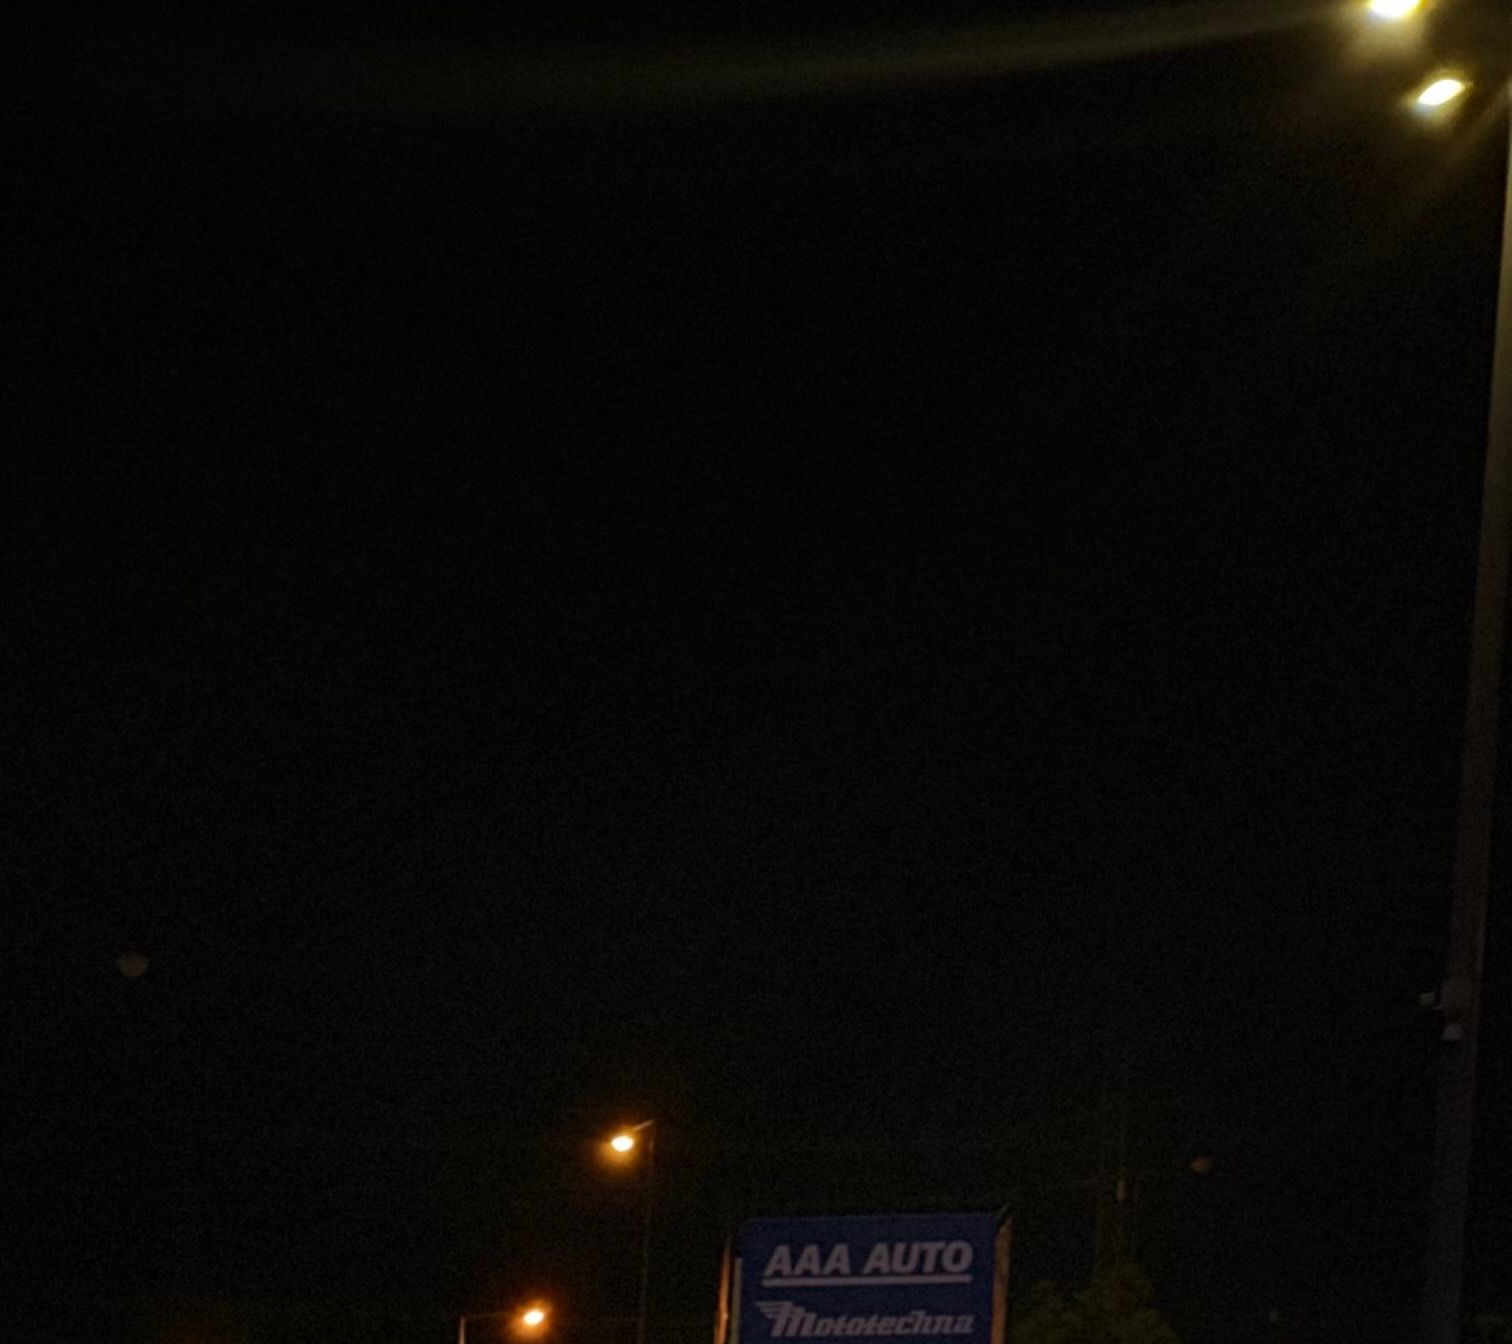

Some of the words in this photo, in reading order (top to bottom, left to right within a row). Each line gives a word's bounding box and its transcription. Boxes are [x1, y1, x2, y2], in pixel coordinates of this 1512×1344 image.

[763, 1243, 851, 1276] AAA
[862, 1240, 974, 1275] AUTO
[755, 1300, 975, 1338] Mototechna
